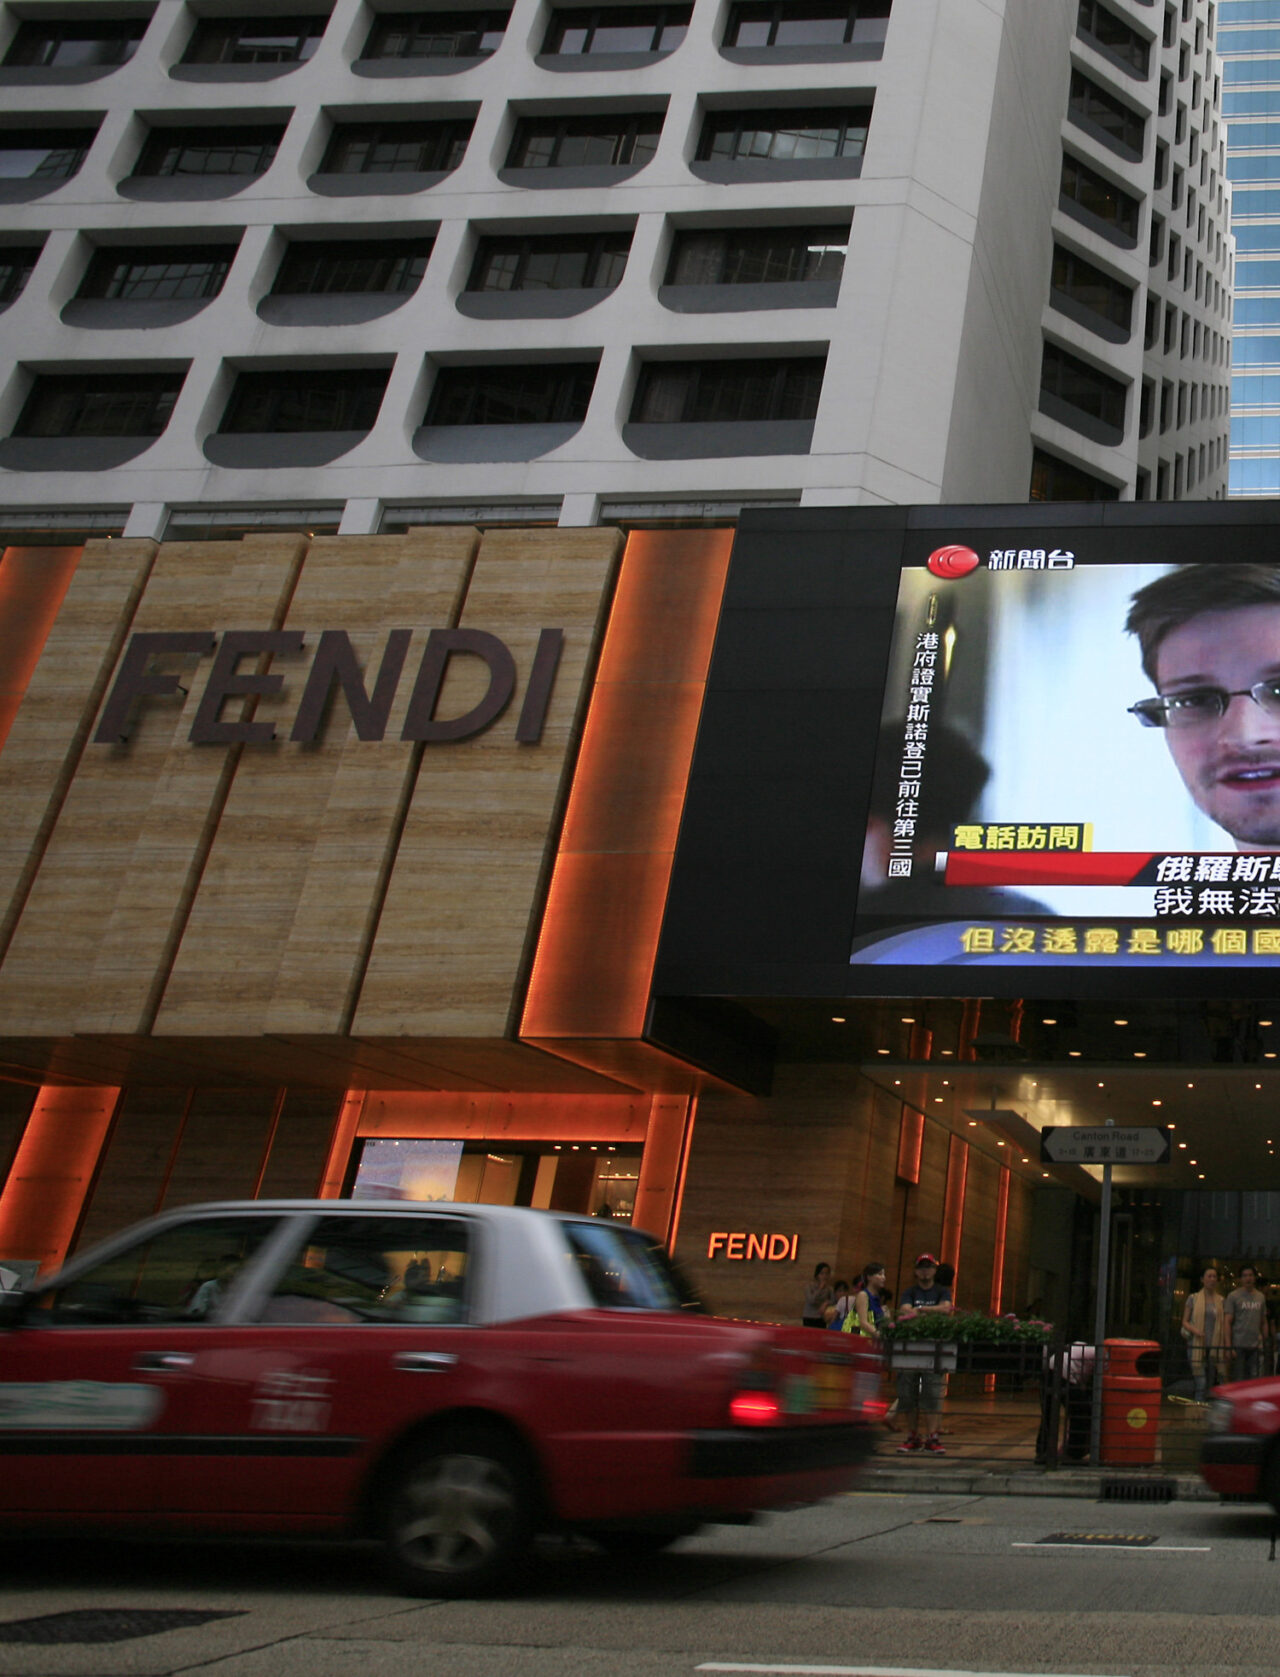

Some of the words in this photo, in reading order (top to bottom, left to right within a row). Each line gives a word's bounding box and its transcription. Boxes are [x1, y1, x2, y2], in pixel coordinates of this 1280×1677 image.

[988, 549, 1075, 571] 新聞台
[94, 628, 563, 743] FENDI
[954, 825, 1078, 850] 電話訪問
[1073, 1131, 1110, 1141] Canton
[1112, 1131, 1140, 1141] Road
[708, 1233, 800, 1261] FENDI
